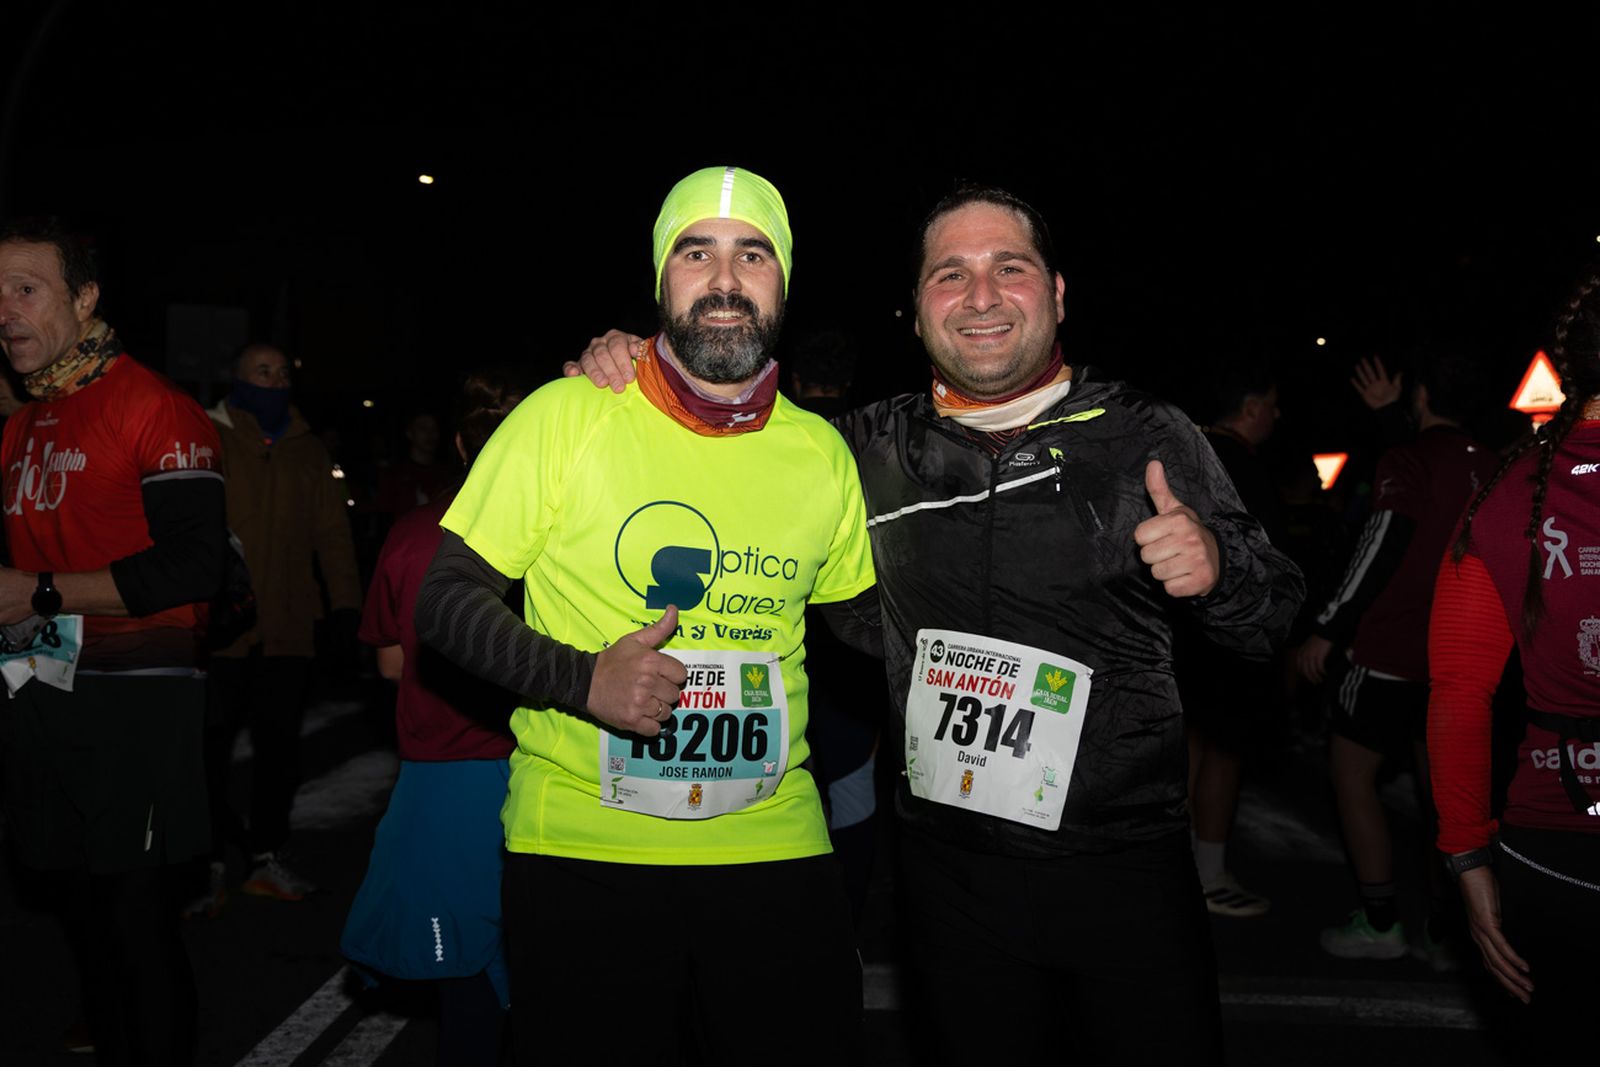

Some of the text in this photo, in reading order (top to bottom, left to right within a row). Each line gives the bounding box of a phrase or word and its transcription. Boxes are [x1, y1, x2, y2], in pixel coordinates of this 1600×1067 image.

[691, 624, 707, 641] y
[931, 645, 944, 657] 43
[945, 650, 1021, 679] NOCHE DE
[706, 671, 725, 686] DE
[926, 667, 1017, 700] SAN ANTÓN
[678, 686, 727, 709] NTÓN
[933, 692, 1036, 760] 7314
[957, 750, 987, 767] David
[658, 766, 733, 779] JOSE RAMON
